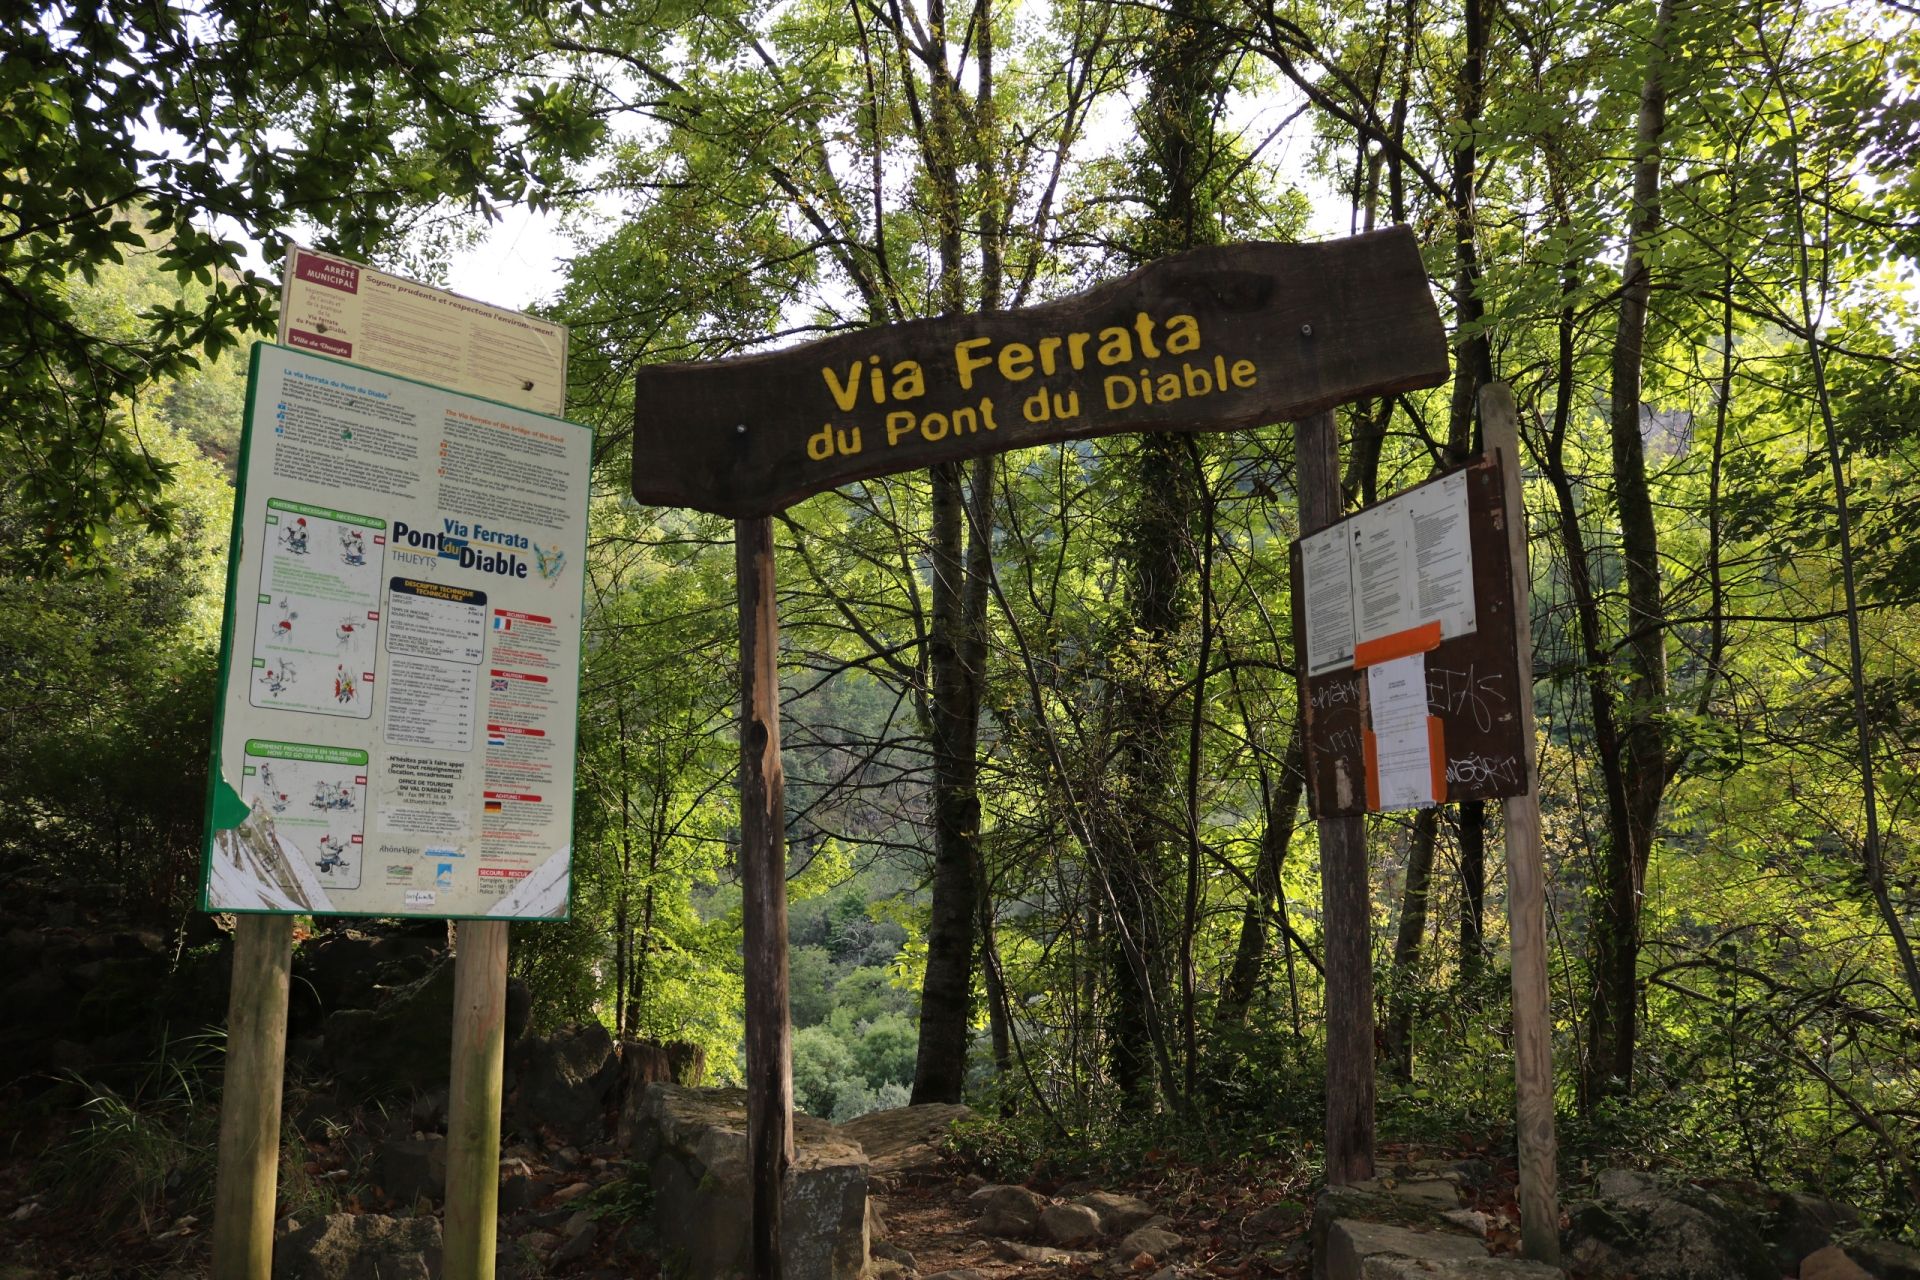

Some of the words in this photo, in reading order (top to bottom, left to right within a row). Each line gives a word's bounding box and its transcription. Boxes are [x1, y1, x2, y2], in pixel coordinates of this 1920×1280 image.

[307, 269, 354, 289] MUNICIPAL
[324, 263, 355, 279] ARRÊTÉ
[366, 275, 396, 291] Soyons
[398, 285, 436, 303] prudents
[439, 297, 447, 305] et
[449, 300, 492, 319] respectons
[292, 335, 308, 345] Ville
[309, 339, 319, 348] de
[320, 342, 348, 355] Thueyts
[822, 354, 925, 412] Via
[955, 312, 1201, 390] Ferrata
[341, 382, 356, 391] Pont
[358, 386, 366, 394] du
[807, 424, 862, 460] du
[886, 397, 997, 446] Pont
[1023, 387, 1080, 423] du
[1104, 355, 1257, 411] Diable
[442, 517, 468, 538] Via
[473, 523, 529, 550] Ferrata
[392, 520, 446, 553] Pont
[445, 541, 460, 555] du
[459, 545, 528, 579] Diable
[392, 549, 437, 568] THUEYTS
[405, 580, 438, 591] DESCRIPTIF
[440, 586, 474, 597] TECHNIQUE
[416, 588, 449, 599] TECHNICAL
[283, 746, 318, 754] PROGRESSER
[421, 765, 462, 775] renseignement
[449, 761, 464, 769] appel
